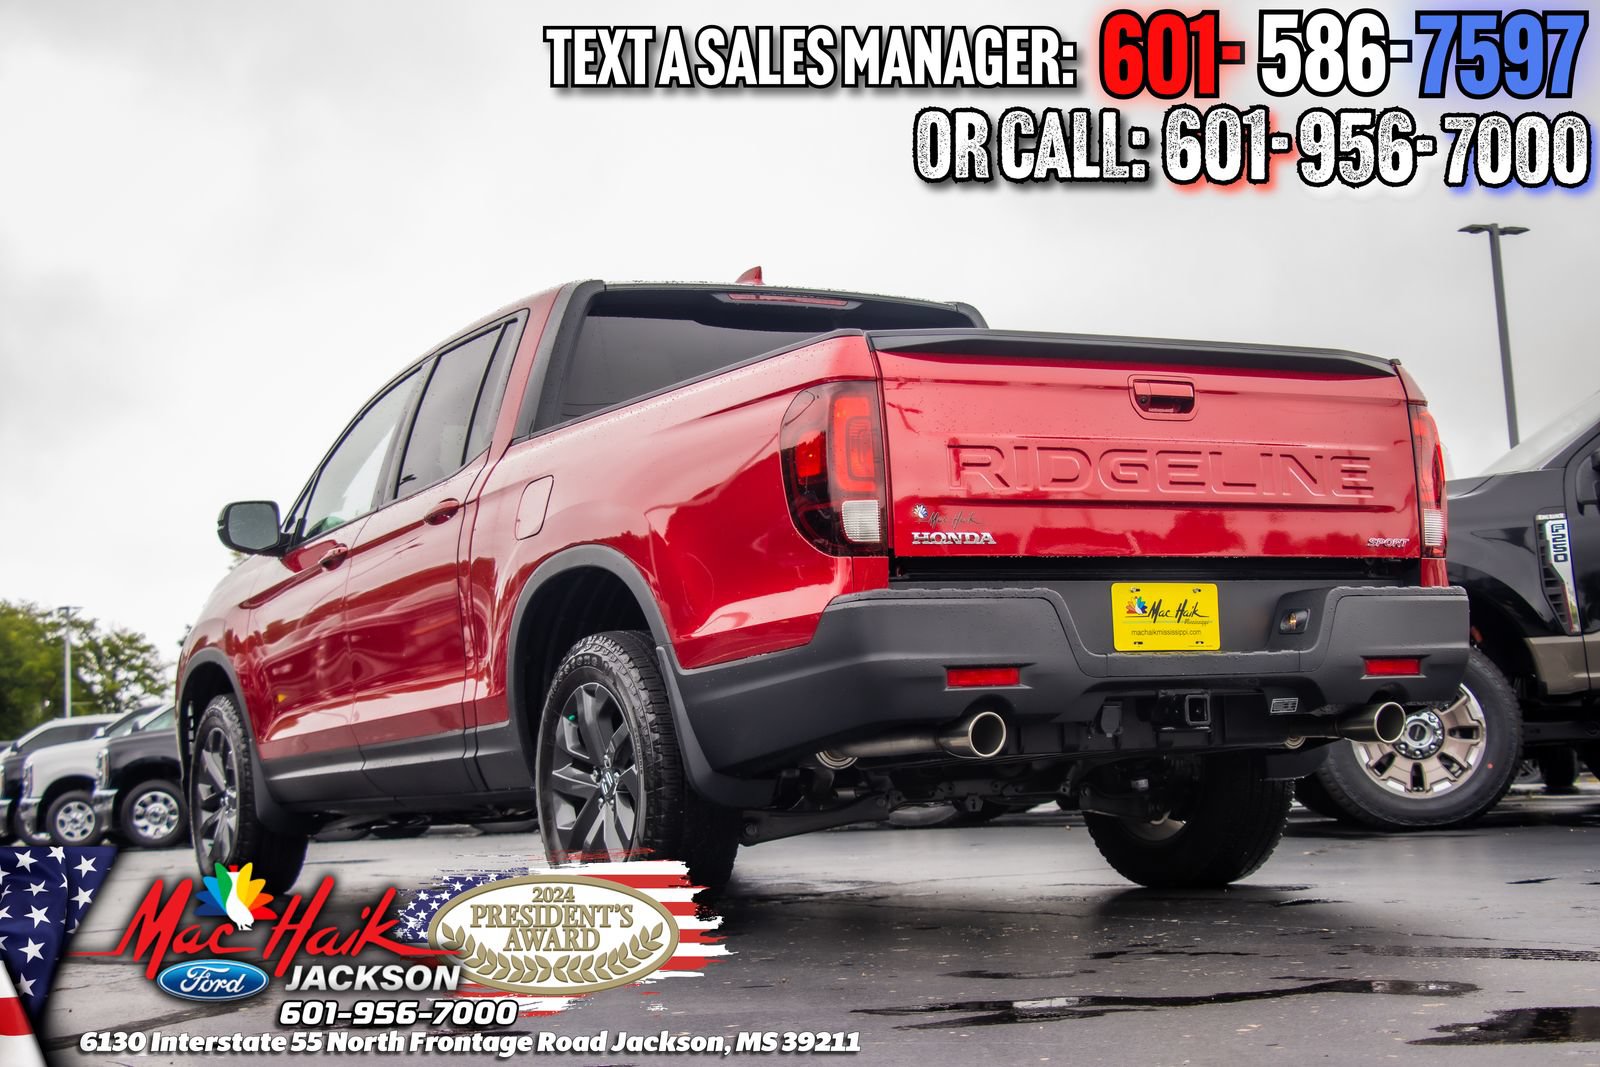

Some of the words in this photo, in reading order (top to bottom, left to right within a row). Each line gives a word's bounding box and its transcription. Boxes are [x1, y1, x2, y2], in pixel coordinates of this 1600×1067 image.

[946, 443, 1376, 499] RIDGELINE
[911, 531, 997, 545] HONDA
[1367, 537, 1409, 548] SPORT
[1147, 599, 1173, 624] Mac
[1175, 599, 1209, 624] Haik
